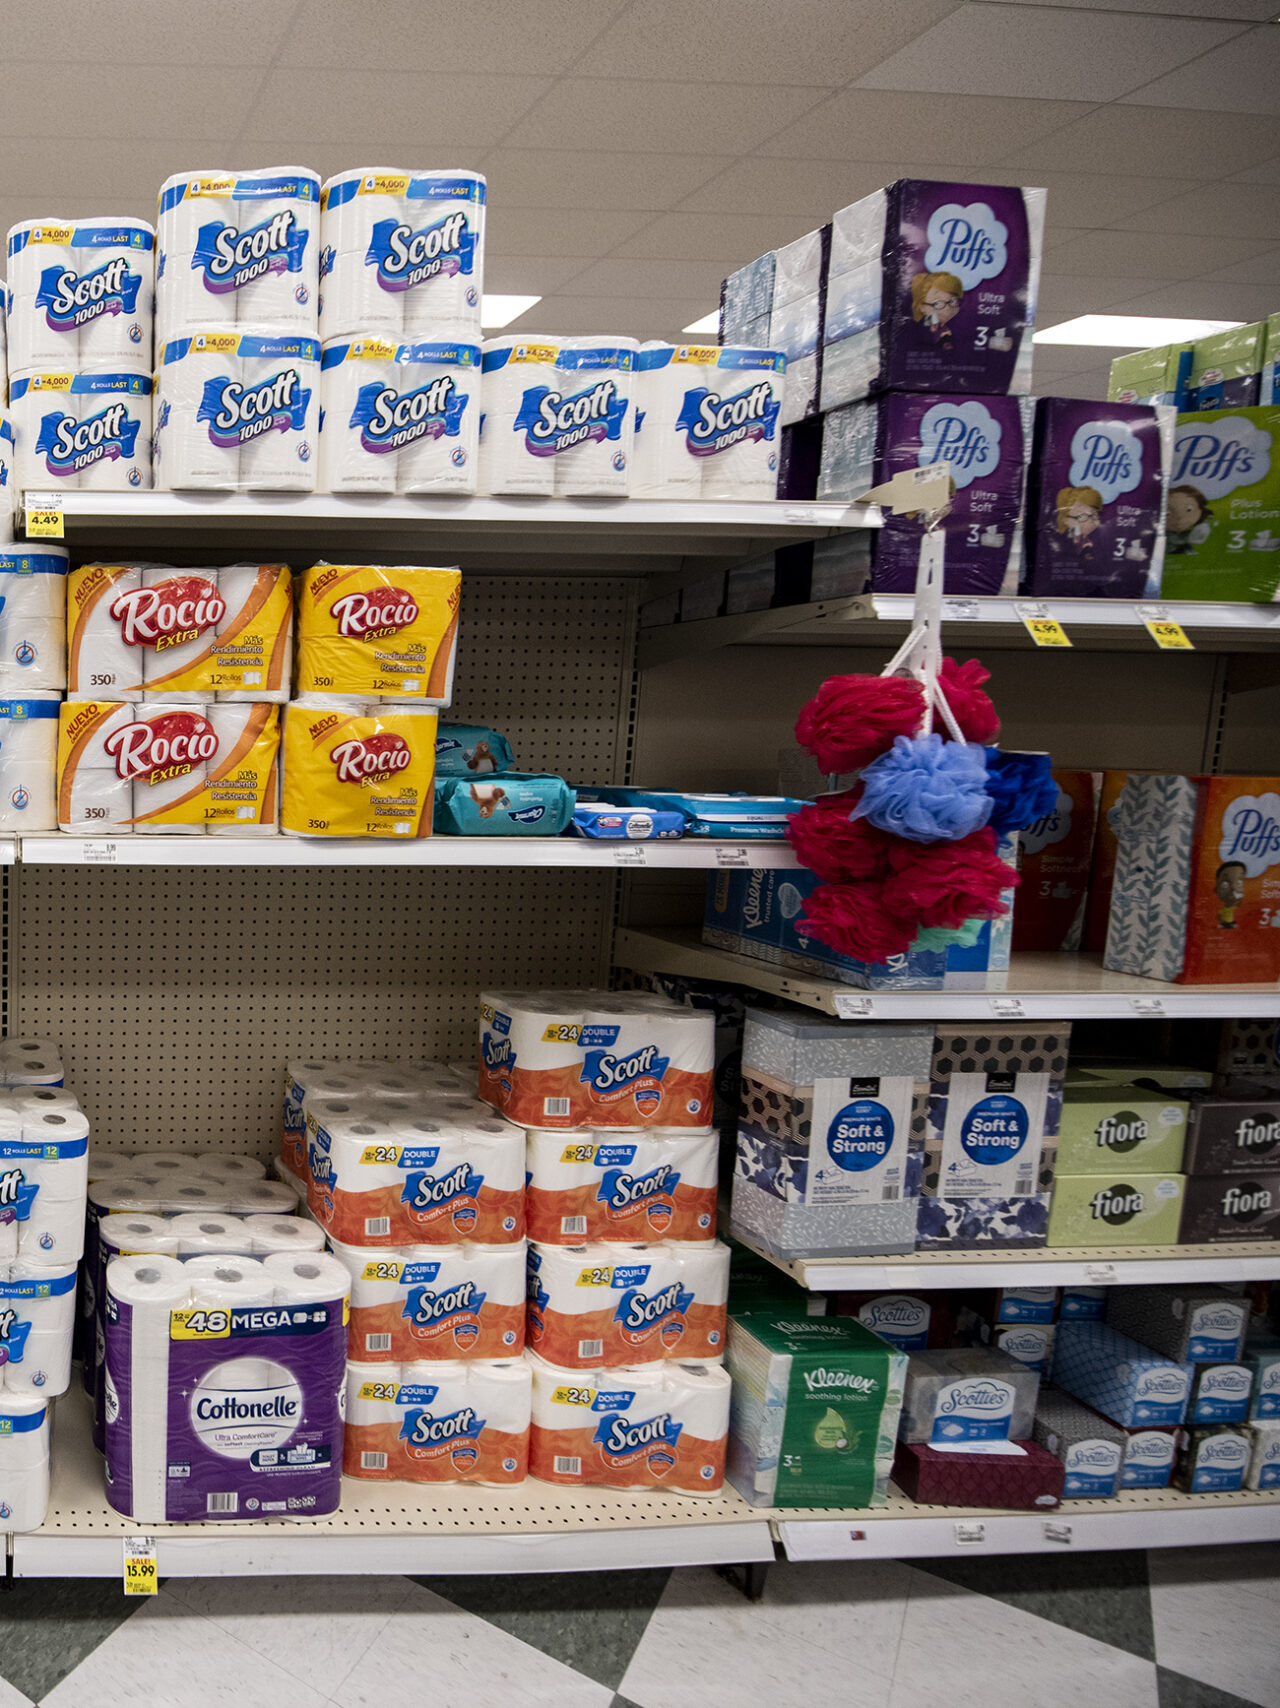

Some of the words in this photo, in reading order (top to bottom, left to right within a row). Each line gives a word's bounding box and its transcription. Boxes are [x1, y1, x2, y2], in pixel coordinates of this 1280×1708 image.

[209, 210, 293, 274] Scott
[384, 212, 465, 272] Scott
[937, 218, 996, 269] Puffs
[52, 257, 127, 314] Scott
[216, 369, 297, 429] Scott
[369, 376, 454, 434] Scott
[532, 380, 614, 438] Scott
[692, 381, 770, 438] Scott
[52, 403, 126, 459] Scott
[931, 417, 990, 468] Puffs
[1080, 434, 1131, 484] Puffs
[1173, 434, 1256, 481] Puffs
[32, 515, 59, 525] 4.49
[74, 568, 105, 604] NUEVO
[155, 628, 199, 653] Extra
[363, 626, 396, 642] Extra
[217, 658, 263, 666] Resistencia
[90, 675, 111, 686] 350
[210, 675, 222, 685] 12
[149, 761, 192, 786] Extra
[360, 771, 391, 788] Extra
[559, 1025, 579, 1041] 24
[582, 1027, 616, 1037] DOUBLE
[598, 1089, 633, 1103] Comfort
[635, 1078, 654, 1089] Plus
[837, 1125, 870, 1138] Soft
[873, 1126, 884, 1137] &
[971, 1118, 1004, 1132] Soft
[1008, 1121, 1019, 1132] &
[1095, 1118, 1148, 1146] fiora
[575, 1145, 593, 1160] 24
[599, 1147, 633, 1157] DOUBLE
[832, 1139, 886, 1155] Strong
[966, 1133, 1020, 1149] Strong
[376, 1146, 397, 1162] 24
[404, 1150, 435, 1158] DOUBLE
[613, 1165, 671, 1206] Scott
[417, 1206, 450, 1222] Comfort
[452, 1198, 470, 1209] Plus
[1090, 1190, 1144, 1219] fiora
[1222, 1188, 1271, 1216] fiora
[376, 1263, 399, 1278] 24
[405, 1265, 437, 1274] DOUBLE
[592, 1268, 610, 1284] 24
[615, 1267, 647, 1278] DOUBLE
[417, 1282, 474, 1320] Scott
[627, 1283, 684, 1327] Scott
[186, 1312, 228, 1331] 48
[231, 1312, 292, 1329] MEGA
[418, 1321, 451, 1338] Comfort
[453, 1314, 472, 1324] Plus
[374, 1383, 395, 1399] 24
[401, 1387, 433, 1397] DOUBLE
[804, 1368, 873, 1393] Kleenex
[568, 1388, 590, 1403] 24
[597, 1392, 631, 1403] DOUBLE
[941, 1388, 1005, 1413] Scotties
[196, 1397, 299, 1420] Cottonelle
[412, 1408, 473, 1444] Scott
[126, 1565, 154, 1577] 15.99
